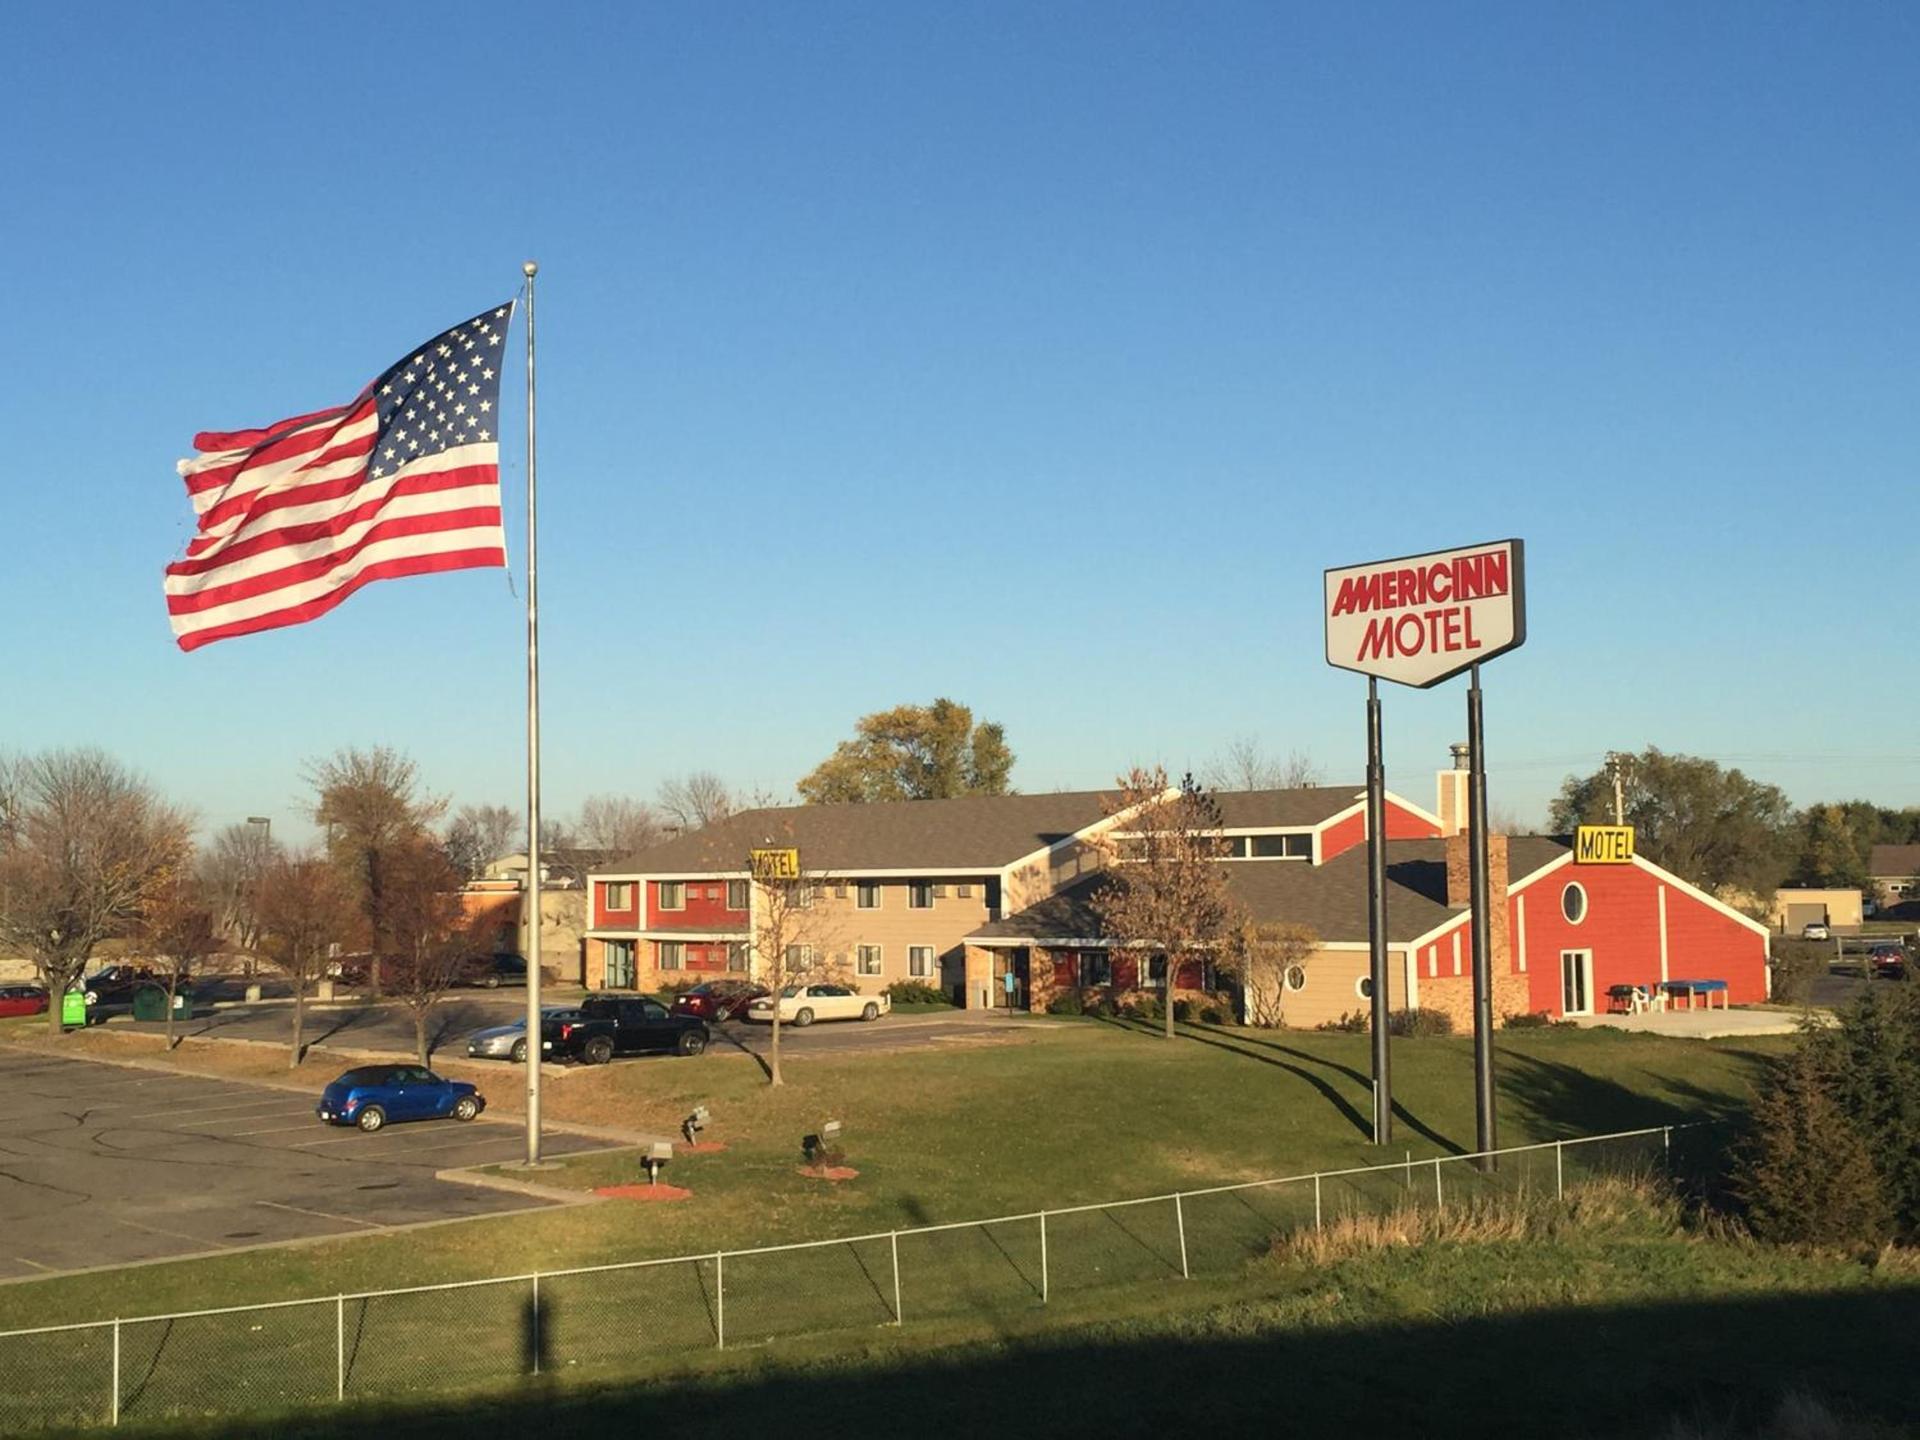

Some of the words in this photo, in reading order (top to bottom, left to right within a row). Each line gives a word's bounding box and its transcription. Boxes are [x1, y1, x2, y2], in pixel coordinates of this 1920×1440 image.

[1331, 550, 1508, 617] AMERICINN
[1357, 606, 1481, 662] MOTEL
[1580, 831, 1632, 860] MOTEL
